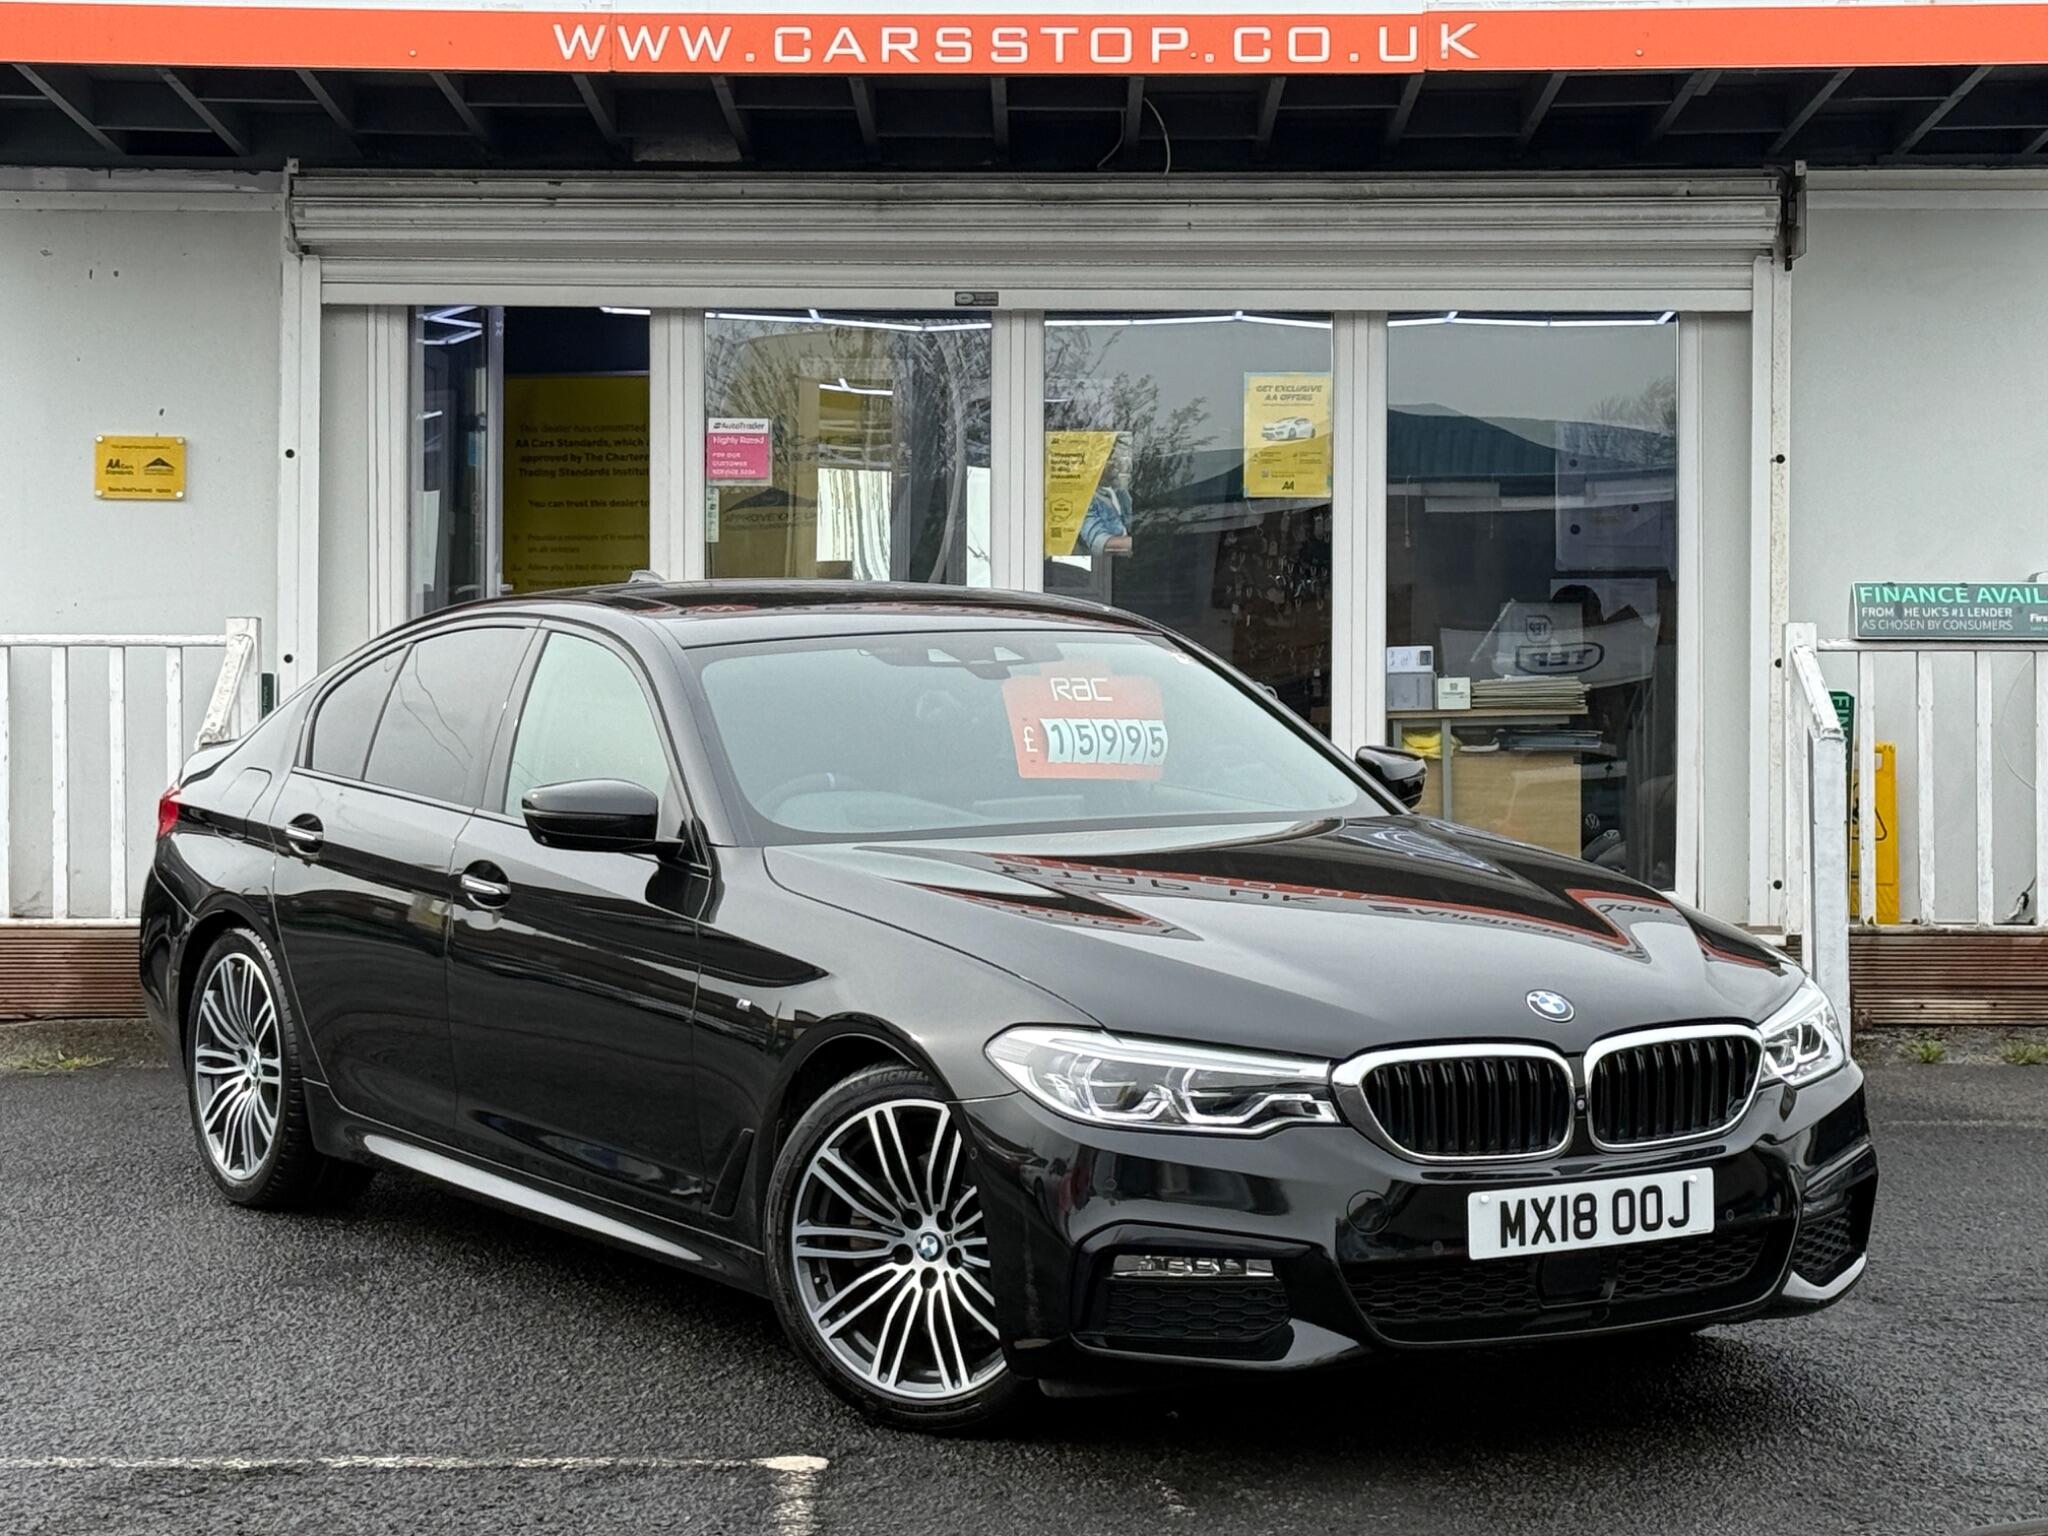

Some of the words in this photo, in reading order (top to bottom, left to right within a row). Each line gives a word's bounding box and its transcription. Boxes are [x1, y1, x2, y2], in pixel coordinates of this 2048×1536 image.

[1256, 384, 1273, 392] GET
[1275, 384, 1322, 393] EXCLUSIVE
[1280, 393, 1313, 402] OFFERS
[515, 439, 529, 448] AA
[531, 439, 554, 448] Cars
[614, 438, 643, 448] which
[584, 452, 603, 462] The
[558, 467, 610, 477] Standards
[609, 499, 638, 508] dealer
[1859, 586, 1971, 604] FINANCE
[1976, 586, 2048, 604] AVAIL
[1861, 606, 1894, 618] FROM
[1896, 606, 1920, 618] HE
[1922, 606, 1949, 618] UK'S
[1967, 606, 2013, 618] LENDER
[1861, 619, 1877, 631] AS
[1877, 619, 1925, 631] CHOSEN
[1927, 619, 1941, 631] BY
[1943, 619, 2014, 632] CONSUMERS
[1050, 724, 1164, 759] 15995
[1499, 1192, 1598, 1249] MX18
[1611, 1180, 1690, 1236] OOJ
